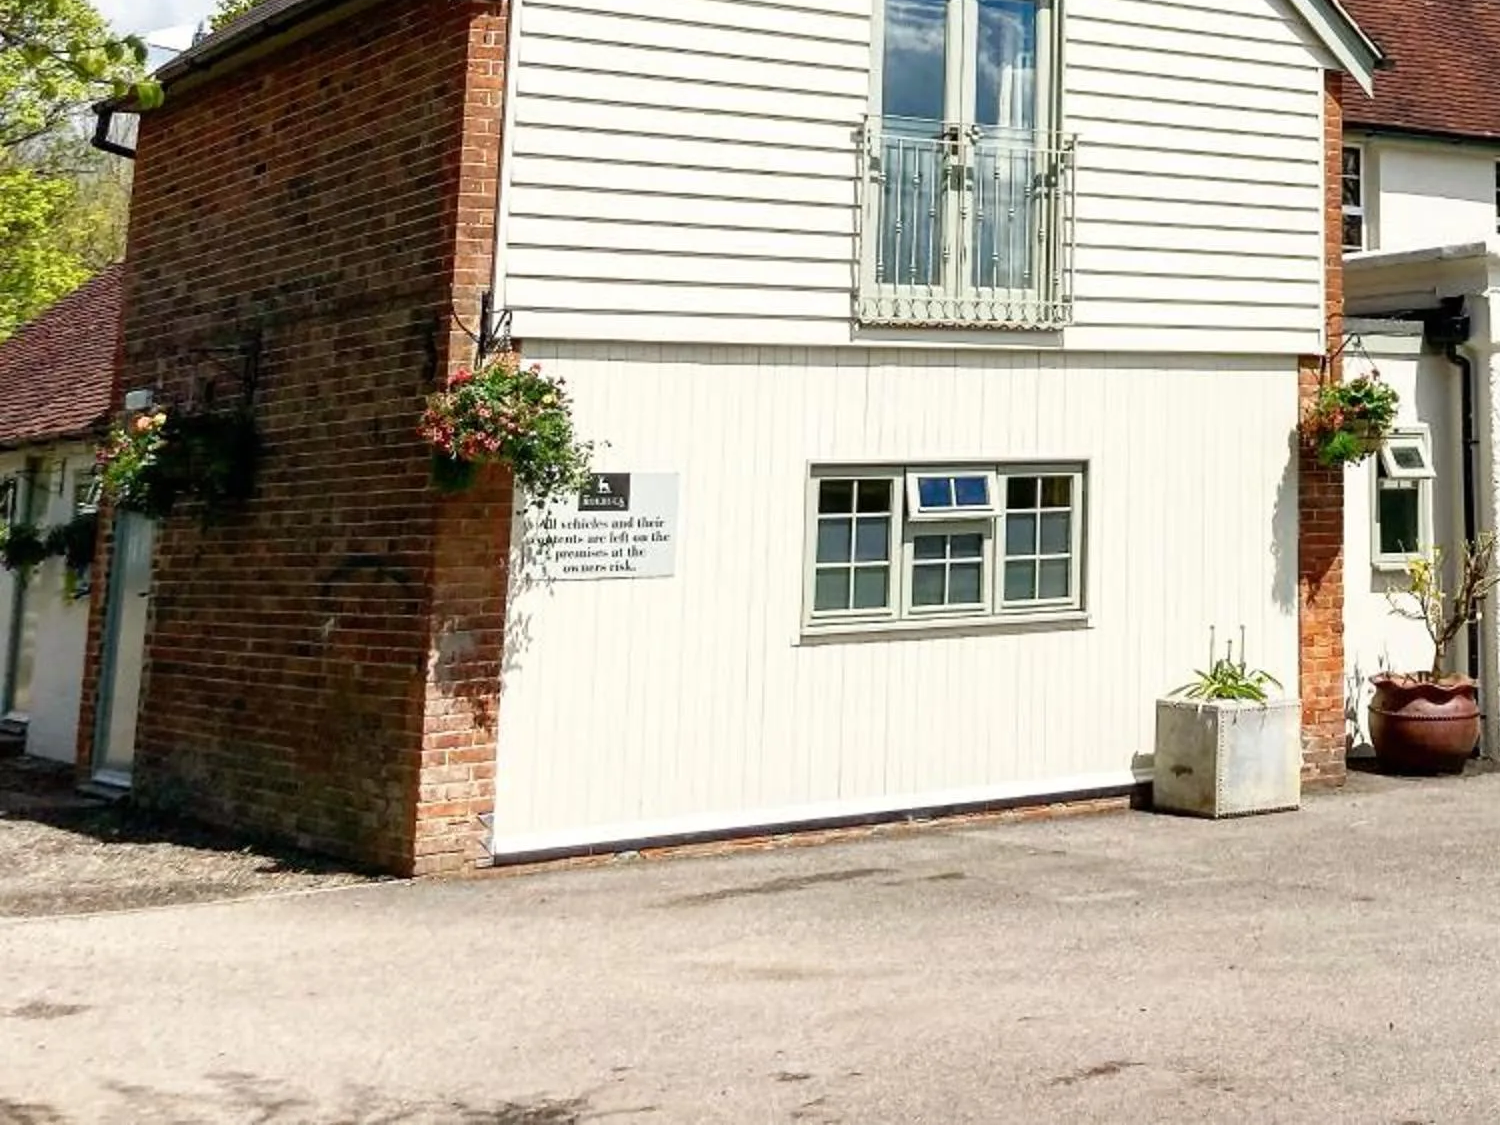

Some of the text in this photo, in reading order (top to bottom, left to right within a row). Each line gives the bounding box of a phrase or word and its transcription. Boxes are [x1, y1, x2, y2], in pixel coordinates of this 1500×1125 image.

[561, 517, 609, 530] vehicles
[611, 516, 634, 529] and
[637, 516, 665, 528] their
[587, 535, 607, 544] are
[609, 531, 629, 544] left
[651, 531, 670, 543] the
[555, 544, 644, 563] premises at the
[563, 564, 607, 573] owners
